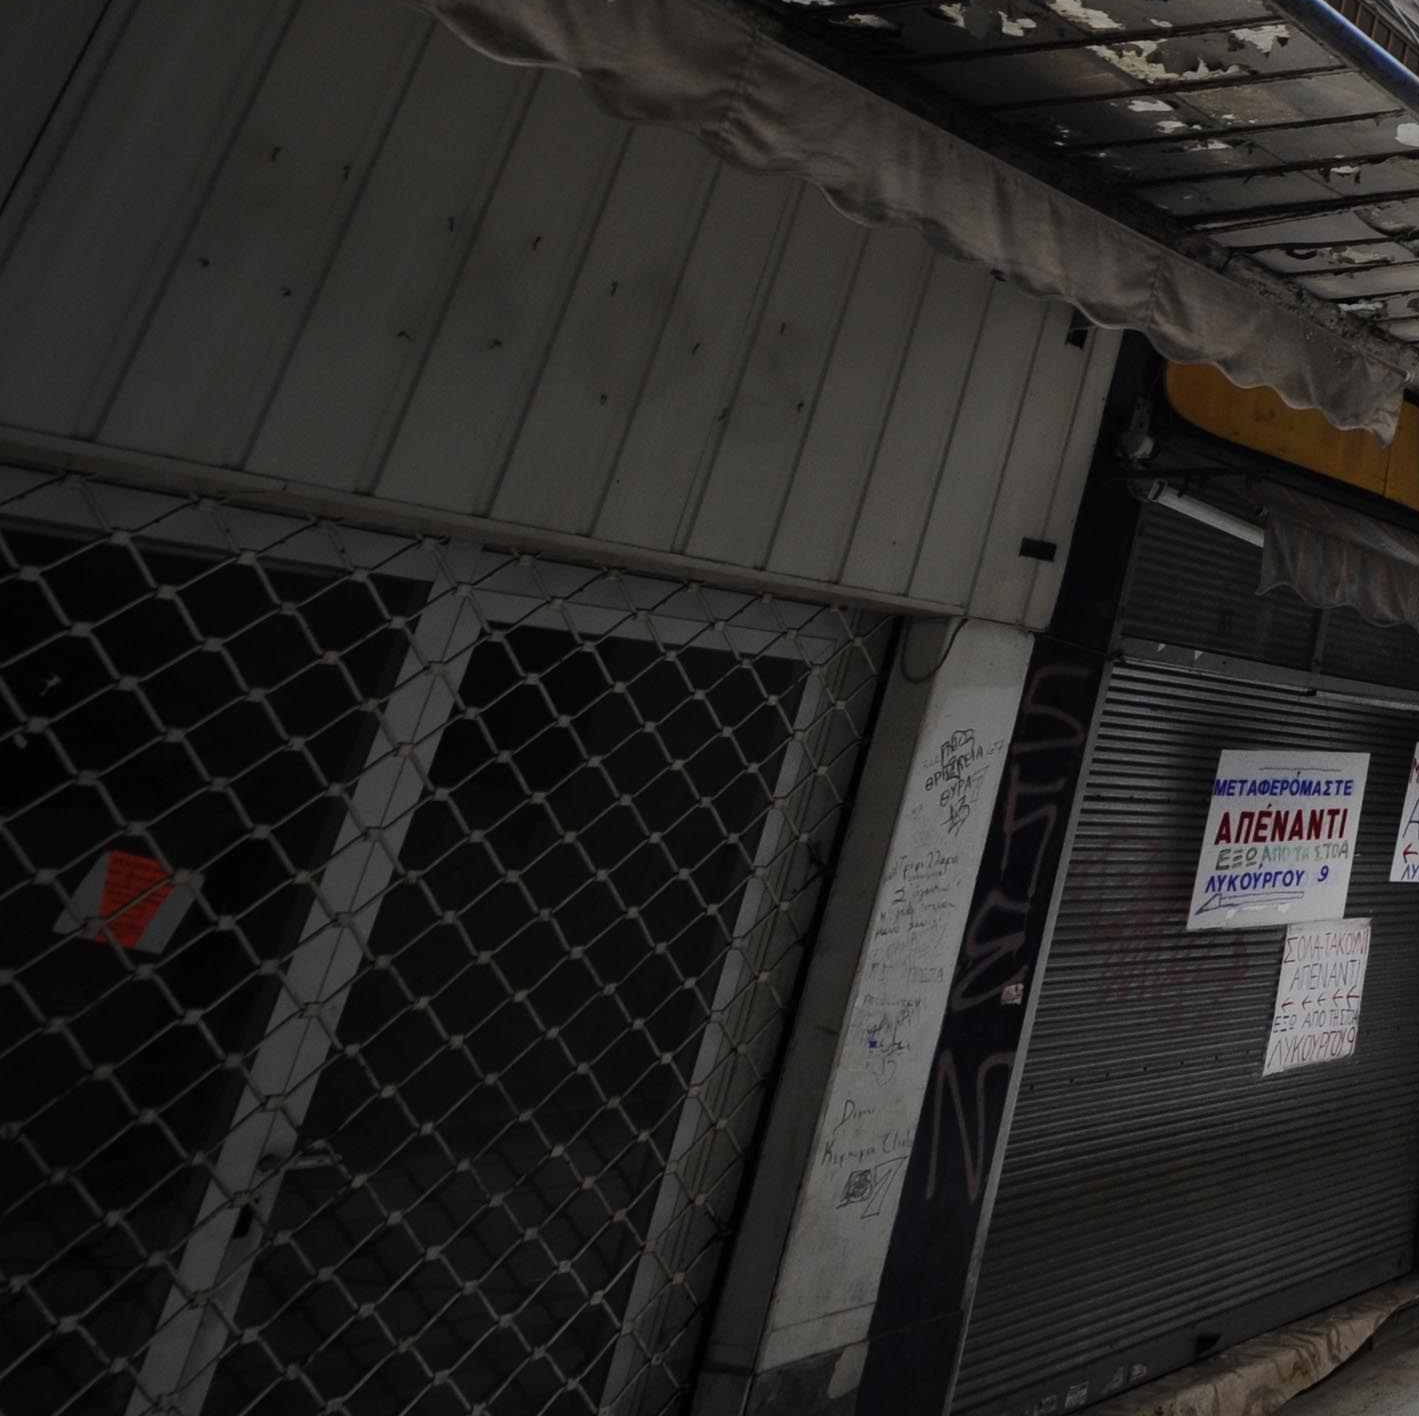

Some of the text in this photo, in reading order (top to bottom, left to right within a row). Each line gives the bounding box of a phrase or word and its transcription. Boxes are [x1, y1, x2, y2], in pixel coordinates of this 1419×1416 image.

[1214, 803, 1348, 845] ΑΠΈΝΑΝΤΙ
[1215, 846, 1258, 871] ΕΞΩ
[1317, 865, 1330, 883] 9
[1290, 960, 1361, 991] ΑΠΕΝΑΝΤΙ
[1273, 1014, 1297, 1033] ΕΞΩ
[1302, 1009, 1326, 1028] ΑΠΟ
[1267, 1026, 1356, 1069] ΛΥΚΟΥΡΓΟΥ 9
